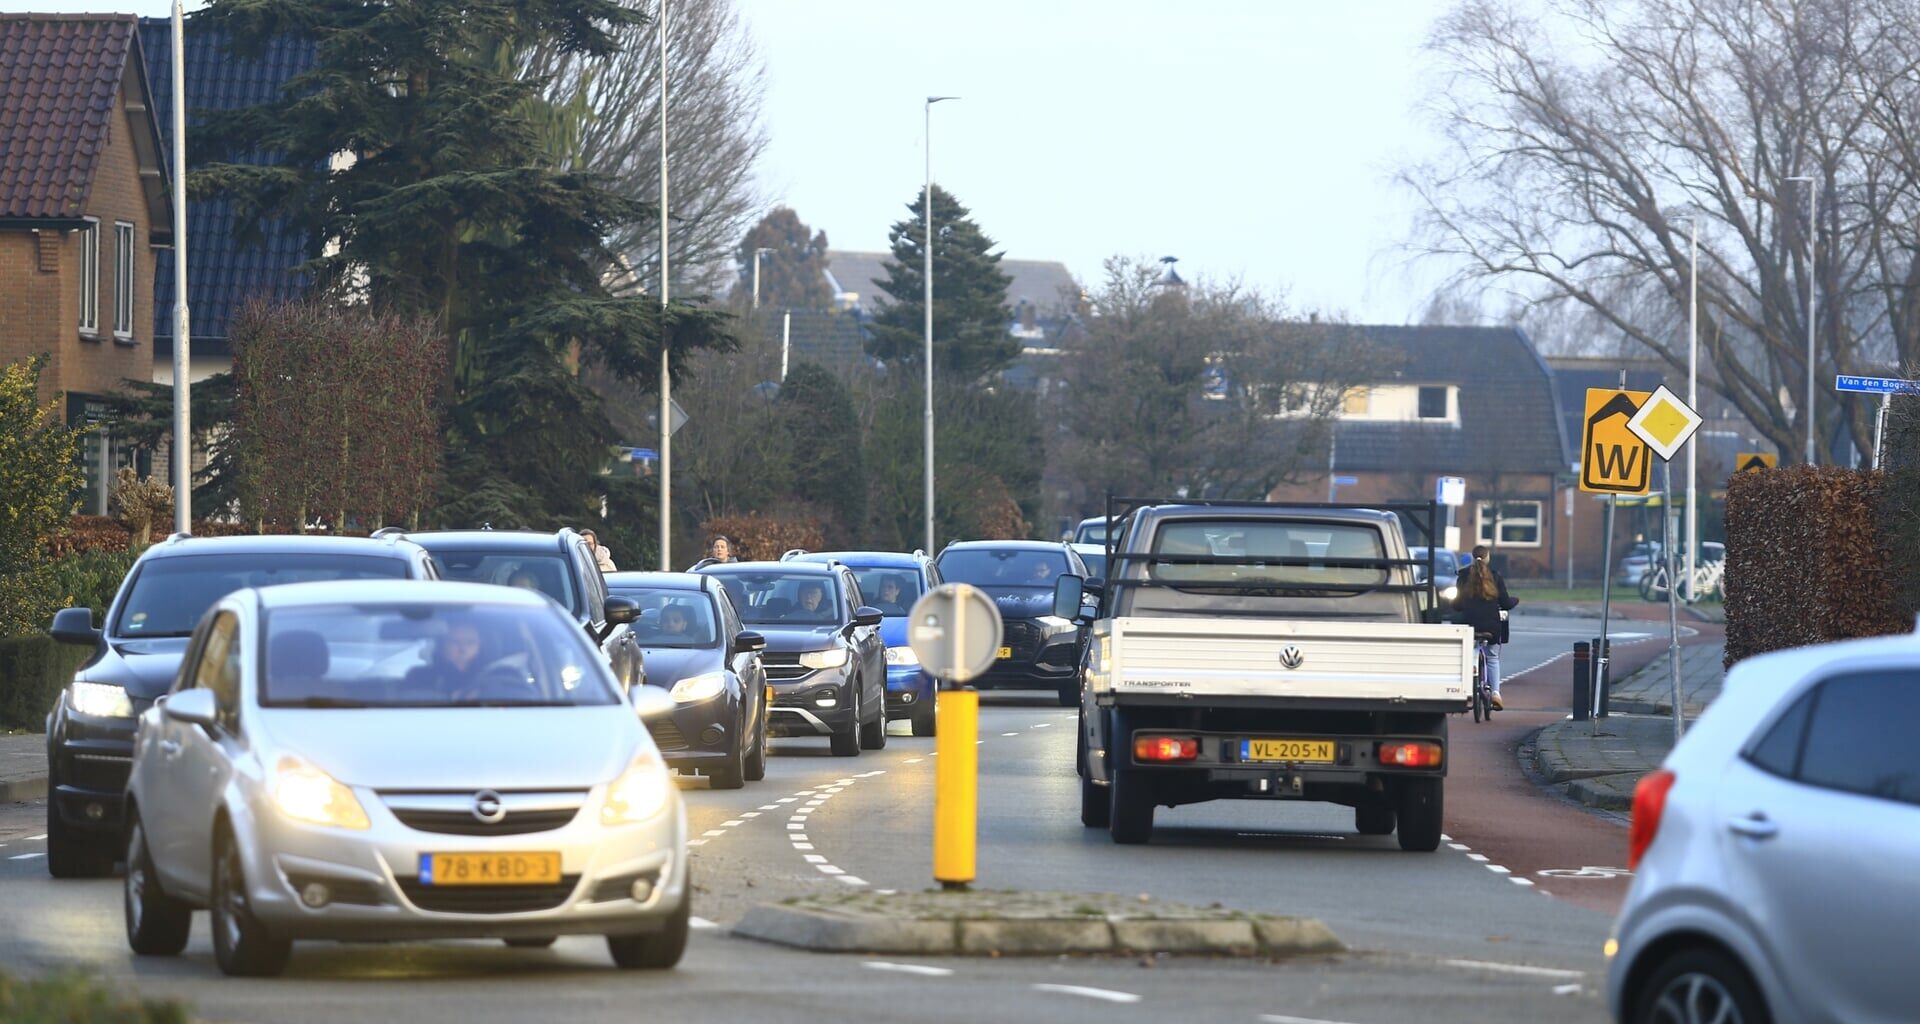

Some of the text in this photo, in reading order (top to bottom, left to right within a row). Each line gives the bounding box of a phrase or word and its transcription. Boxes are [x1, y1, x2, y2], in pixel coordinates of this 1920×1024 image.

[1842, 377, 1859, 386] Van
[1862, 379, 1879, 387] den
[1595, 443, 1639, 480] W
[1253, 743, 1328, 758] VL-205-N
[440, 857, 551, 878] 78-KBD-3
